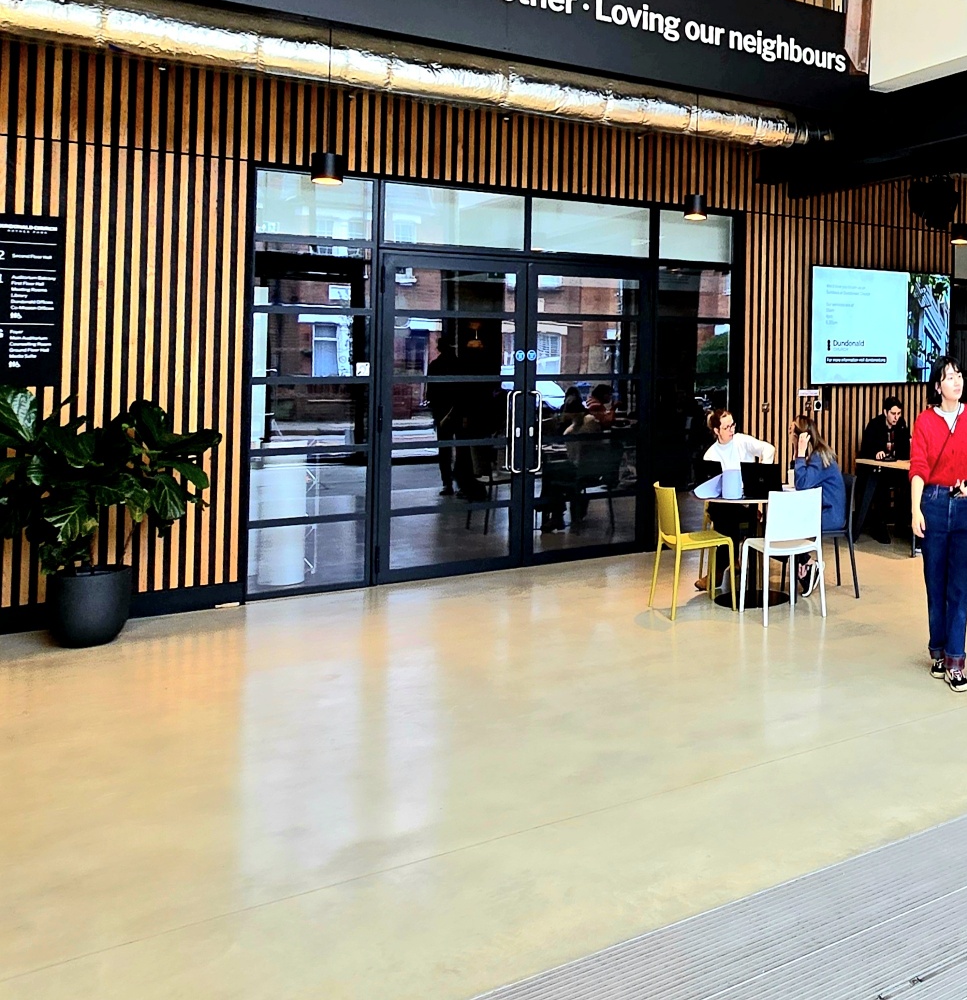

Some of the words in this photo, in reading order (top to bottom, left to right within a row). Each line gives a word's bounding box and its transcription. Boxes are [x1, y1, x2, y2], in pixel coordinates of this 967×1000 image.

[684, 20, 726, 46] our
[728, 29, 846, 73] neighbours
[833, 339, 865, 347] Dundonald
